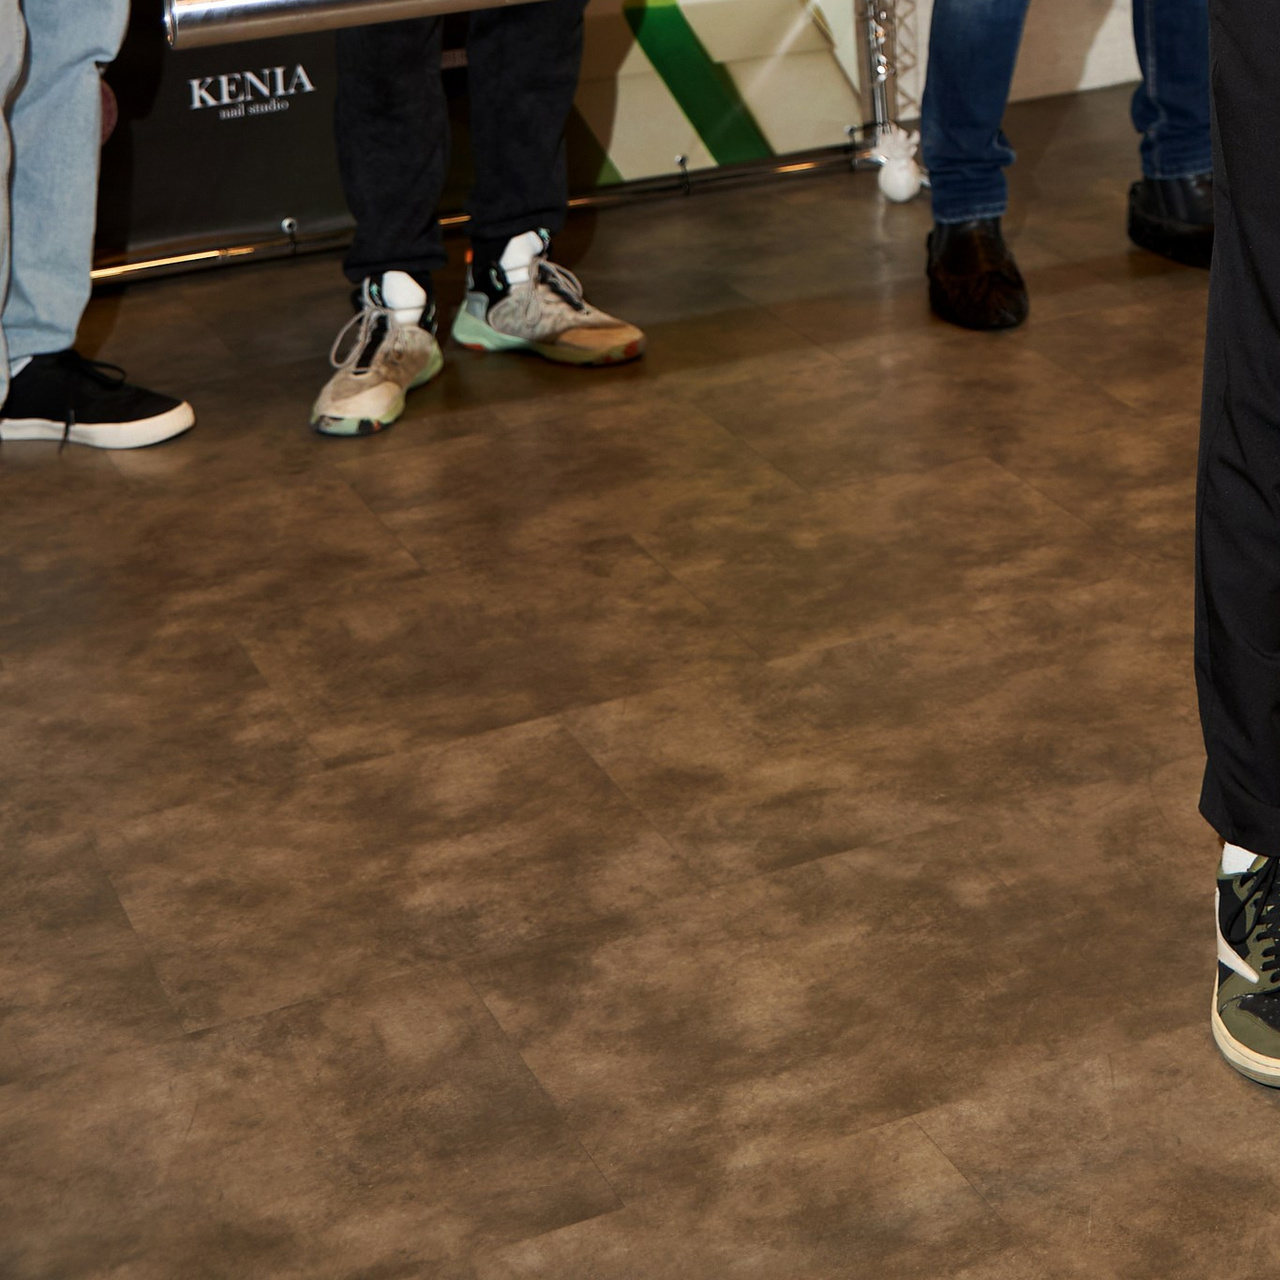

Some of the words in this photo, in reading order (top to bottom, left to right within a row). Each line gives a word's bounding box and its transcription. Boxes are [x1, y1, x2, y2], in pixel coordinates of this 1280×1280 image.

[187, 63, 317, 111] KENIA
[219, 100, 246, 121] nail
[247, 96, 290, 116] studio
